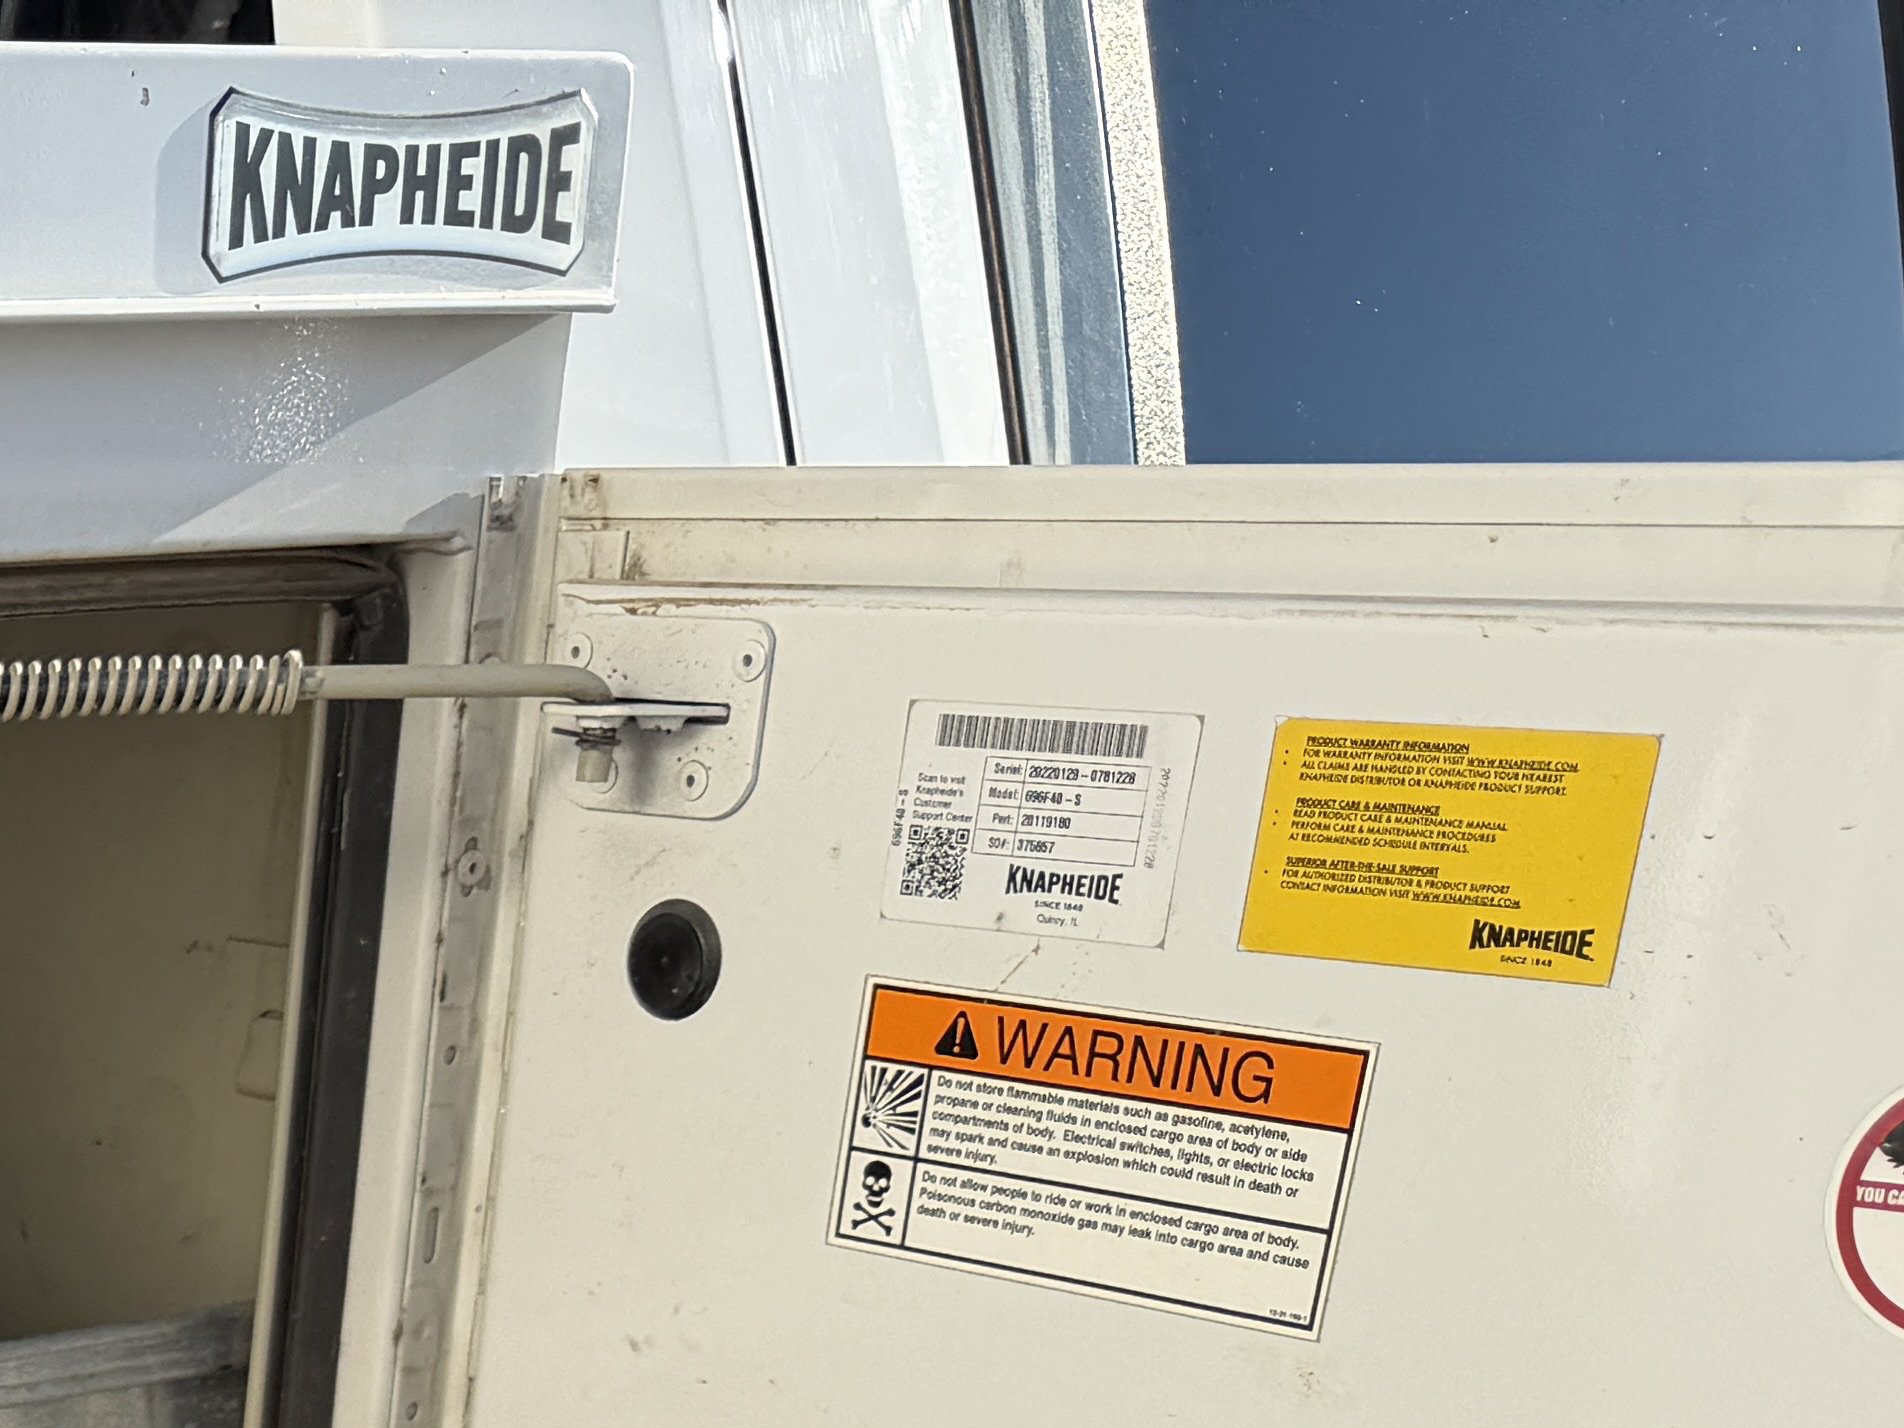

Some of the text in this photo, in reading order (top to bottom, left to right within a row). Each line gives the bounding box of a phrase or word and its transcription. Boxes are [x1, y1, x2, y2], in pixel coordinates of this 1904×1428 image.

[228, 120, 582, 252] KNAPHEIDE
[917, 771, 939, 783] Scan
[939, 774, 949, 785] to
[912, 809, 974, 823] Support Center
[1004, 863, 1124, 906] KNAPHEIDE
[1468, 918, 1596, 961] KNAPHEIDE
[997, 1015, 1275, 1105] WARNING
[933, 1094, 1308, 1163] propane or cleaning fluids in enclosed cargo area of body or side
[936, 1074, 1290, 1144] Do not store flammable materials such as gasoline, acetylene,
[926, 1143, 998, 1166] severe injury.
[929, 1127, 1300, 1198] may spark and cause an explosion which could result in death or
[931, 1110, 1315, 1183] compartments of body. Electrical switches, lights, or electric locks
[916, 1203, 1035, 1238] death or severe injury.
[918, 1186, 1310, 1270] Poisonous carbon monoxide gas may leak into cargo area and cause
[921, 1170, 1300, 1252] Do not allow people to ride or work in enclosed cargo area of body.
[1856, 1185, 1886, 1204] YOU
